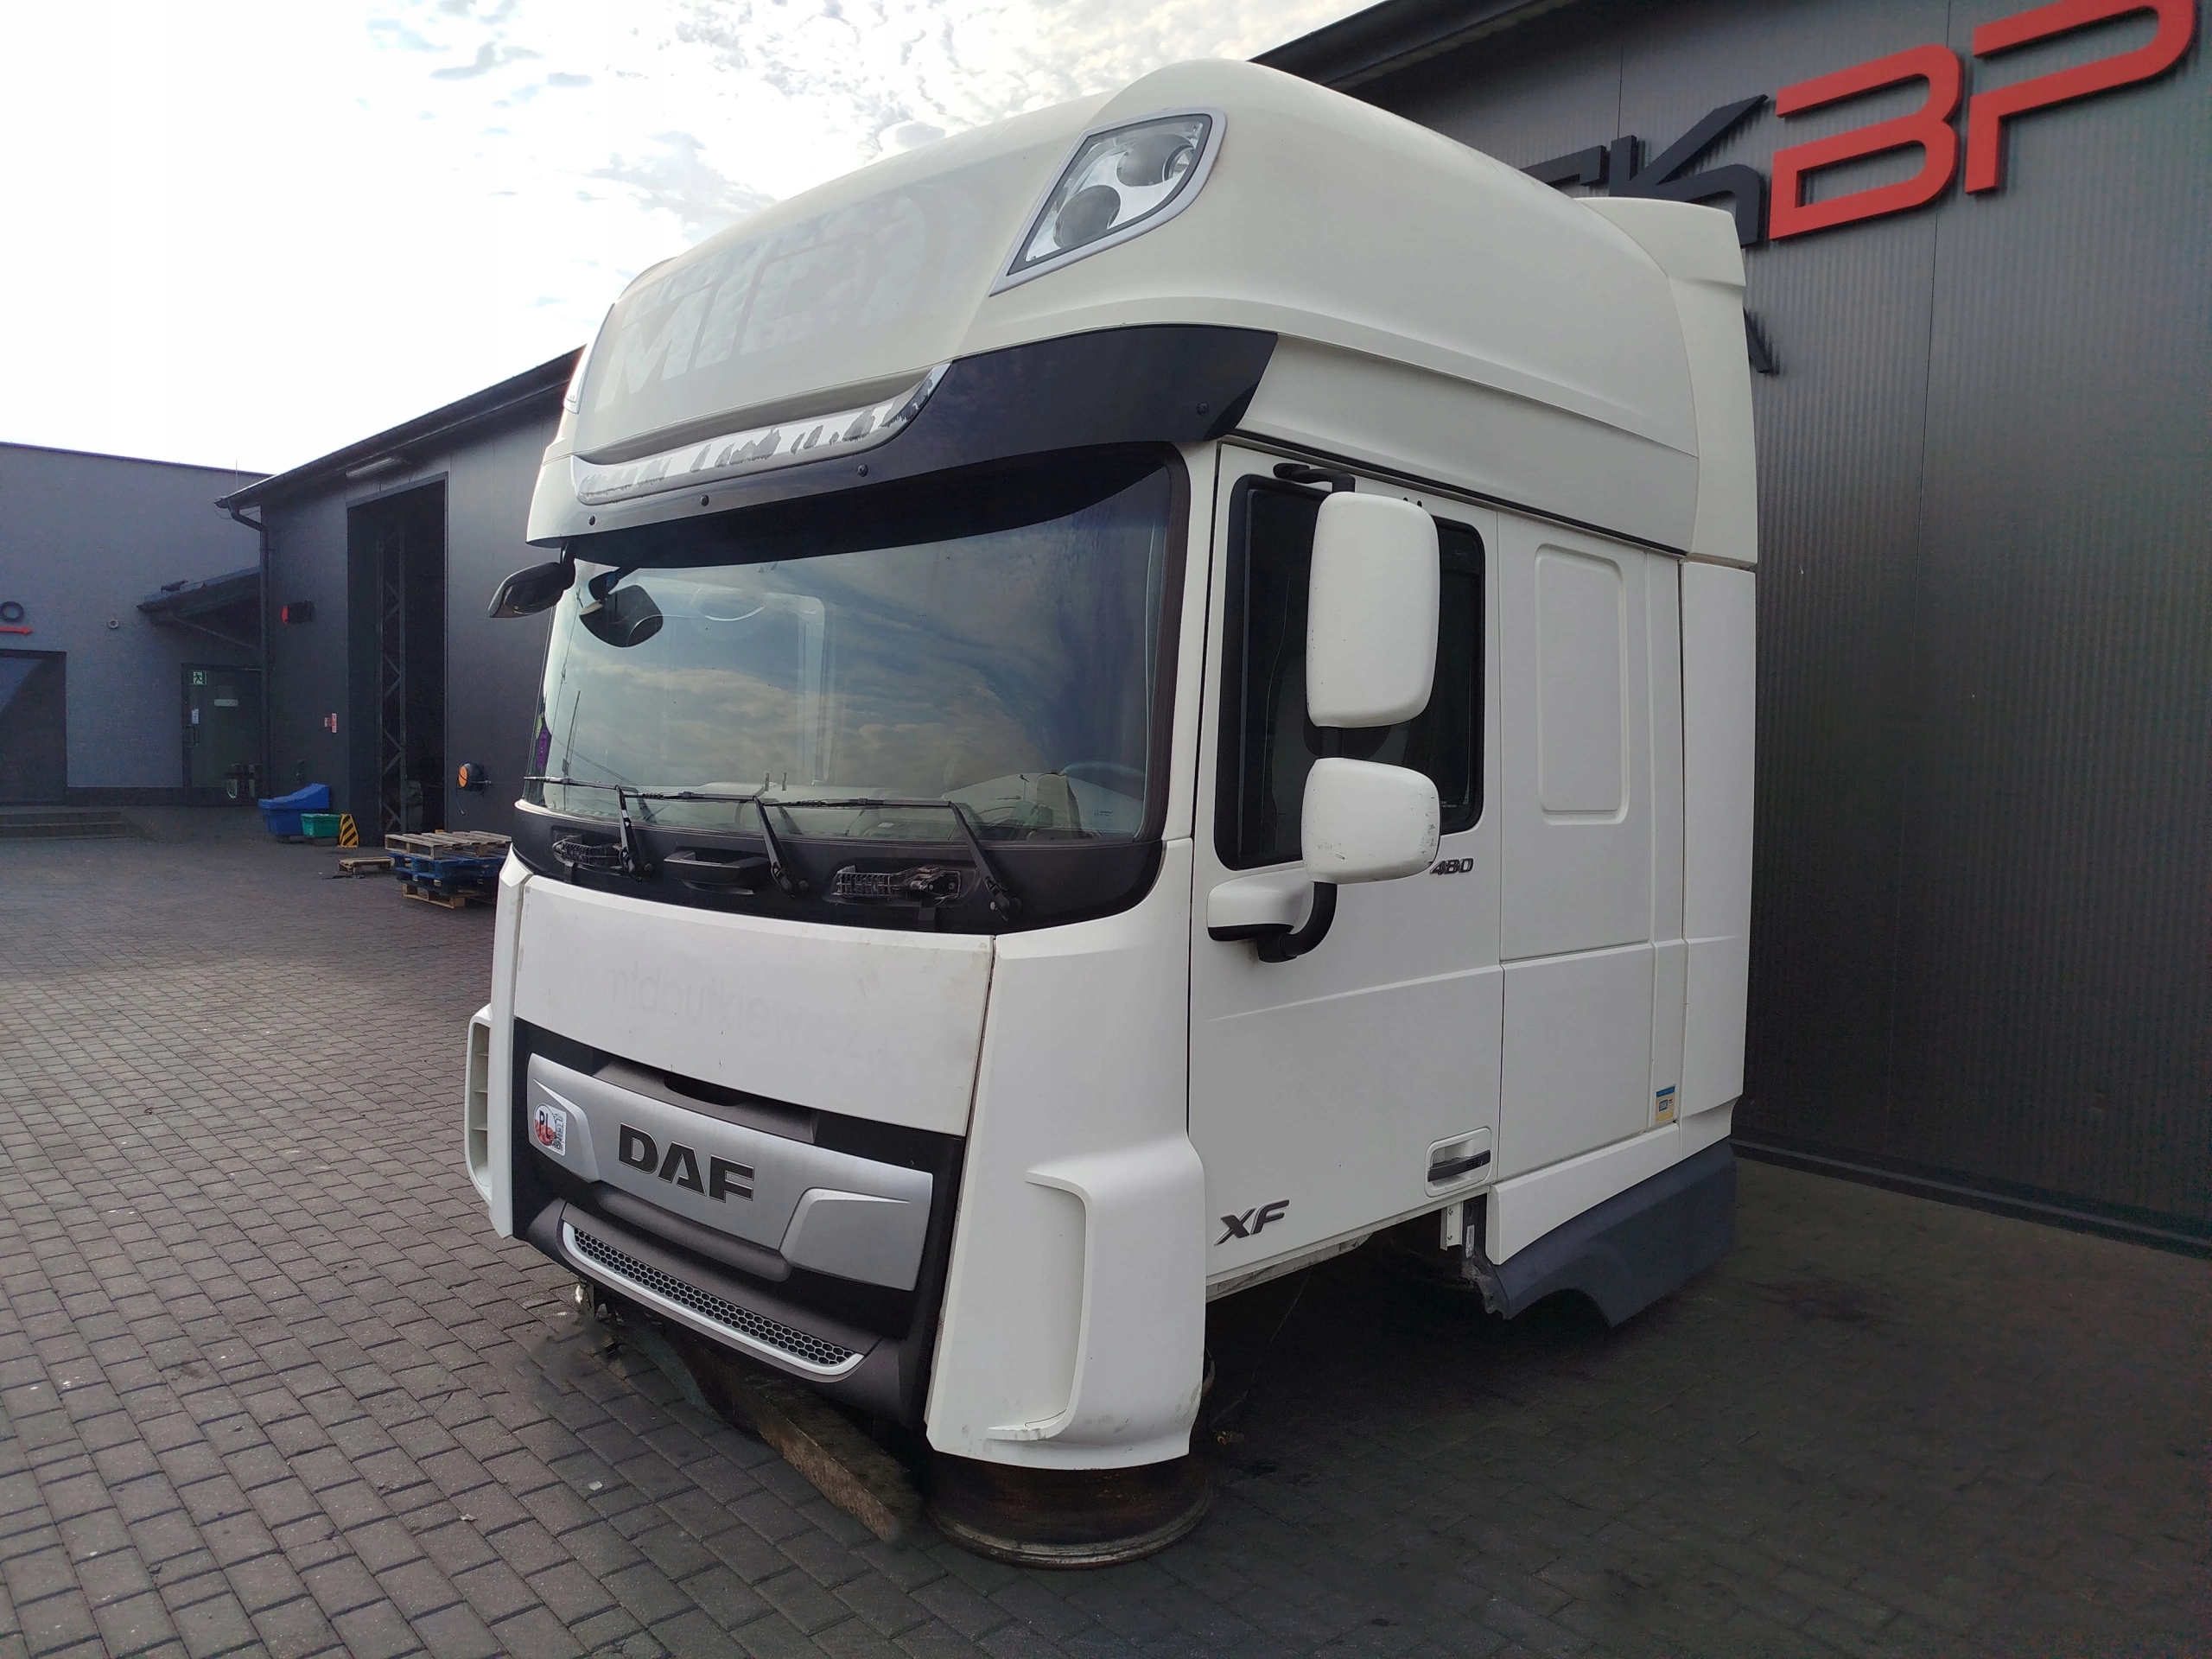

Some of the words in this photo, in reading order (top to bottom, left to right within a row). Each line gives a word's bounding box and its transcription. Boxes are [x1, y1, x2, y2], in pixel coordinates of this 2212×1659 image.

[1428, 857, 1474, 875] 480
[538, 1109, 551, 1141] PL
[618, 1122, 755, 1203] DAF
[1214, 1198, 1290, 1246] XF
